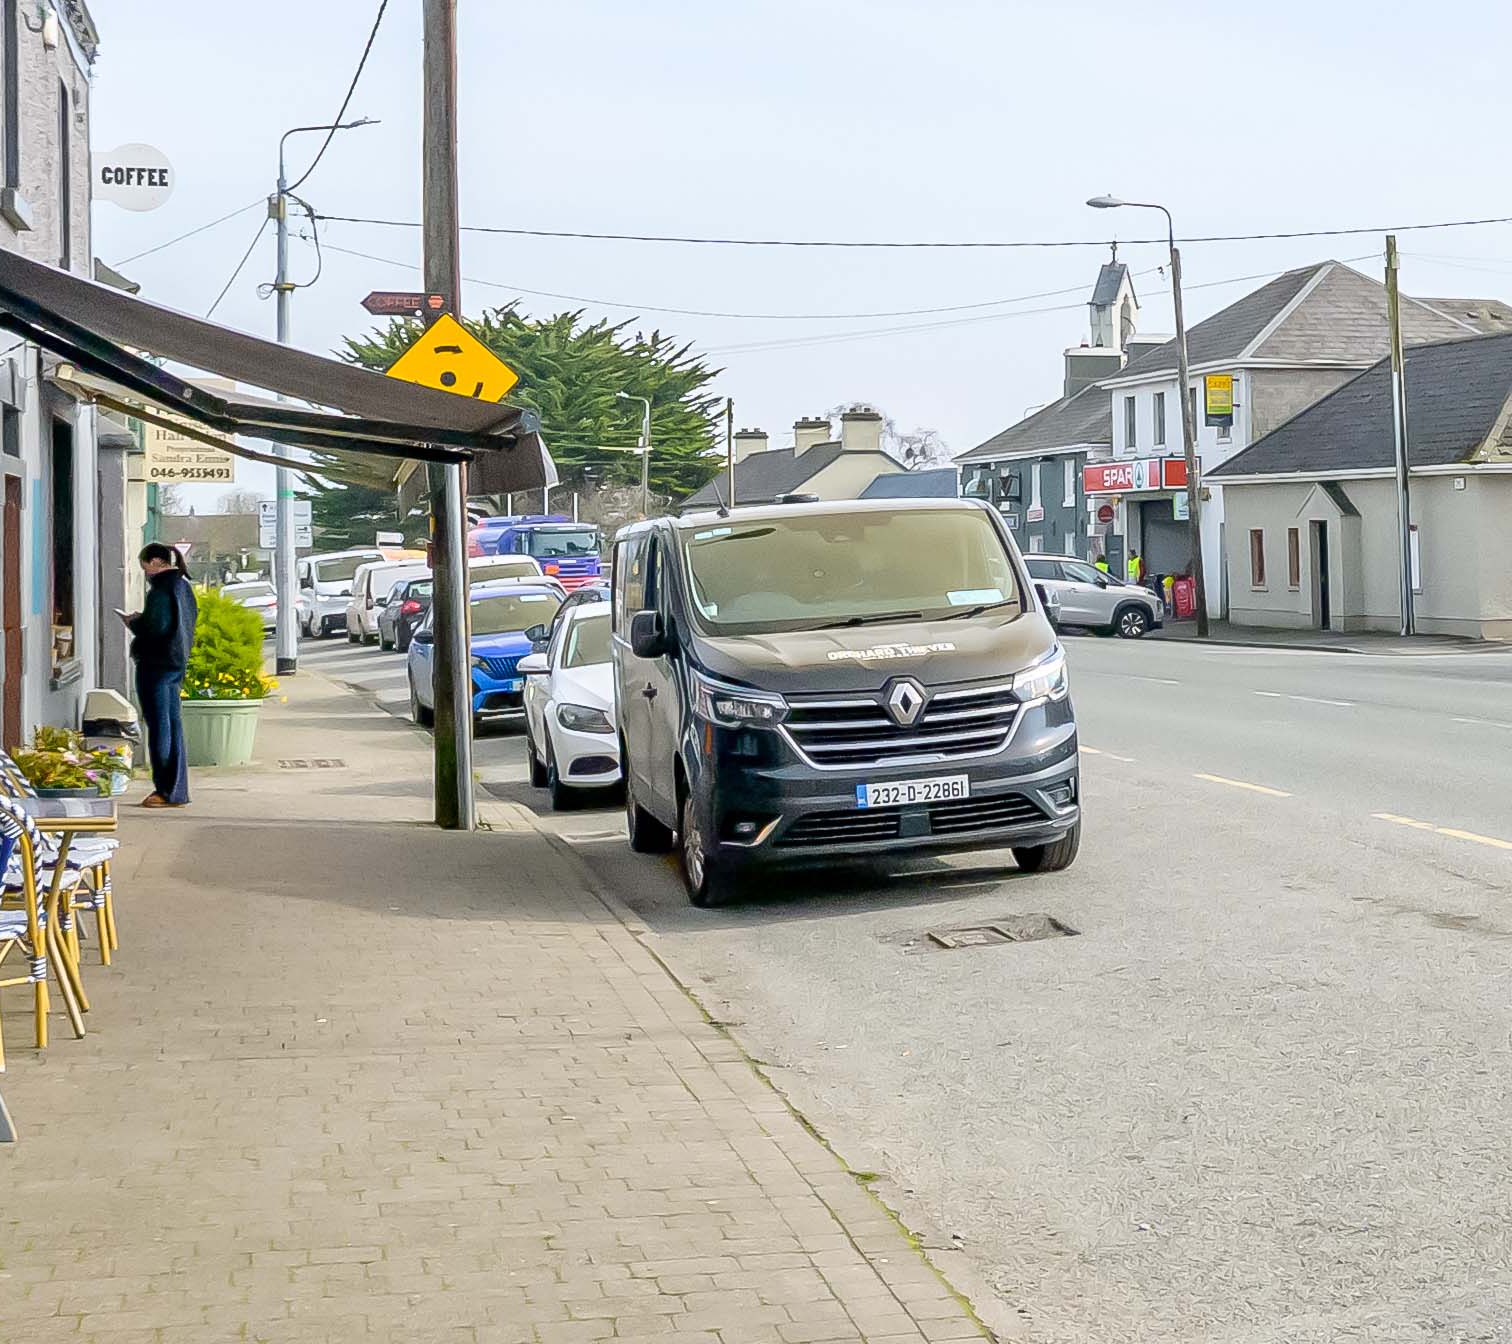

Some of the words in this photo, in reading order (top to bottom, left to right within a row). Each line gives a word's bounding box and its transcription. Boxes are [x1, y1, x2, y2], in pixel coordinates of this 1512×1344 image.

[101, 166, 169, 187] COFFEE
[1103, 467, 1134, 487] SPAR
[872, 780, 965, 805] 232-D-22861
